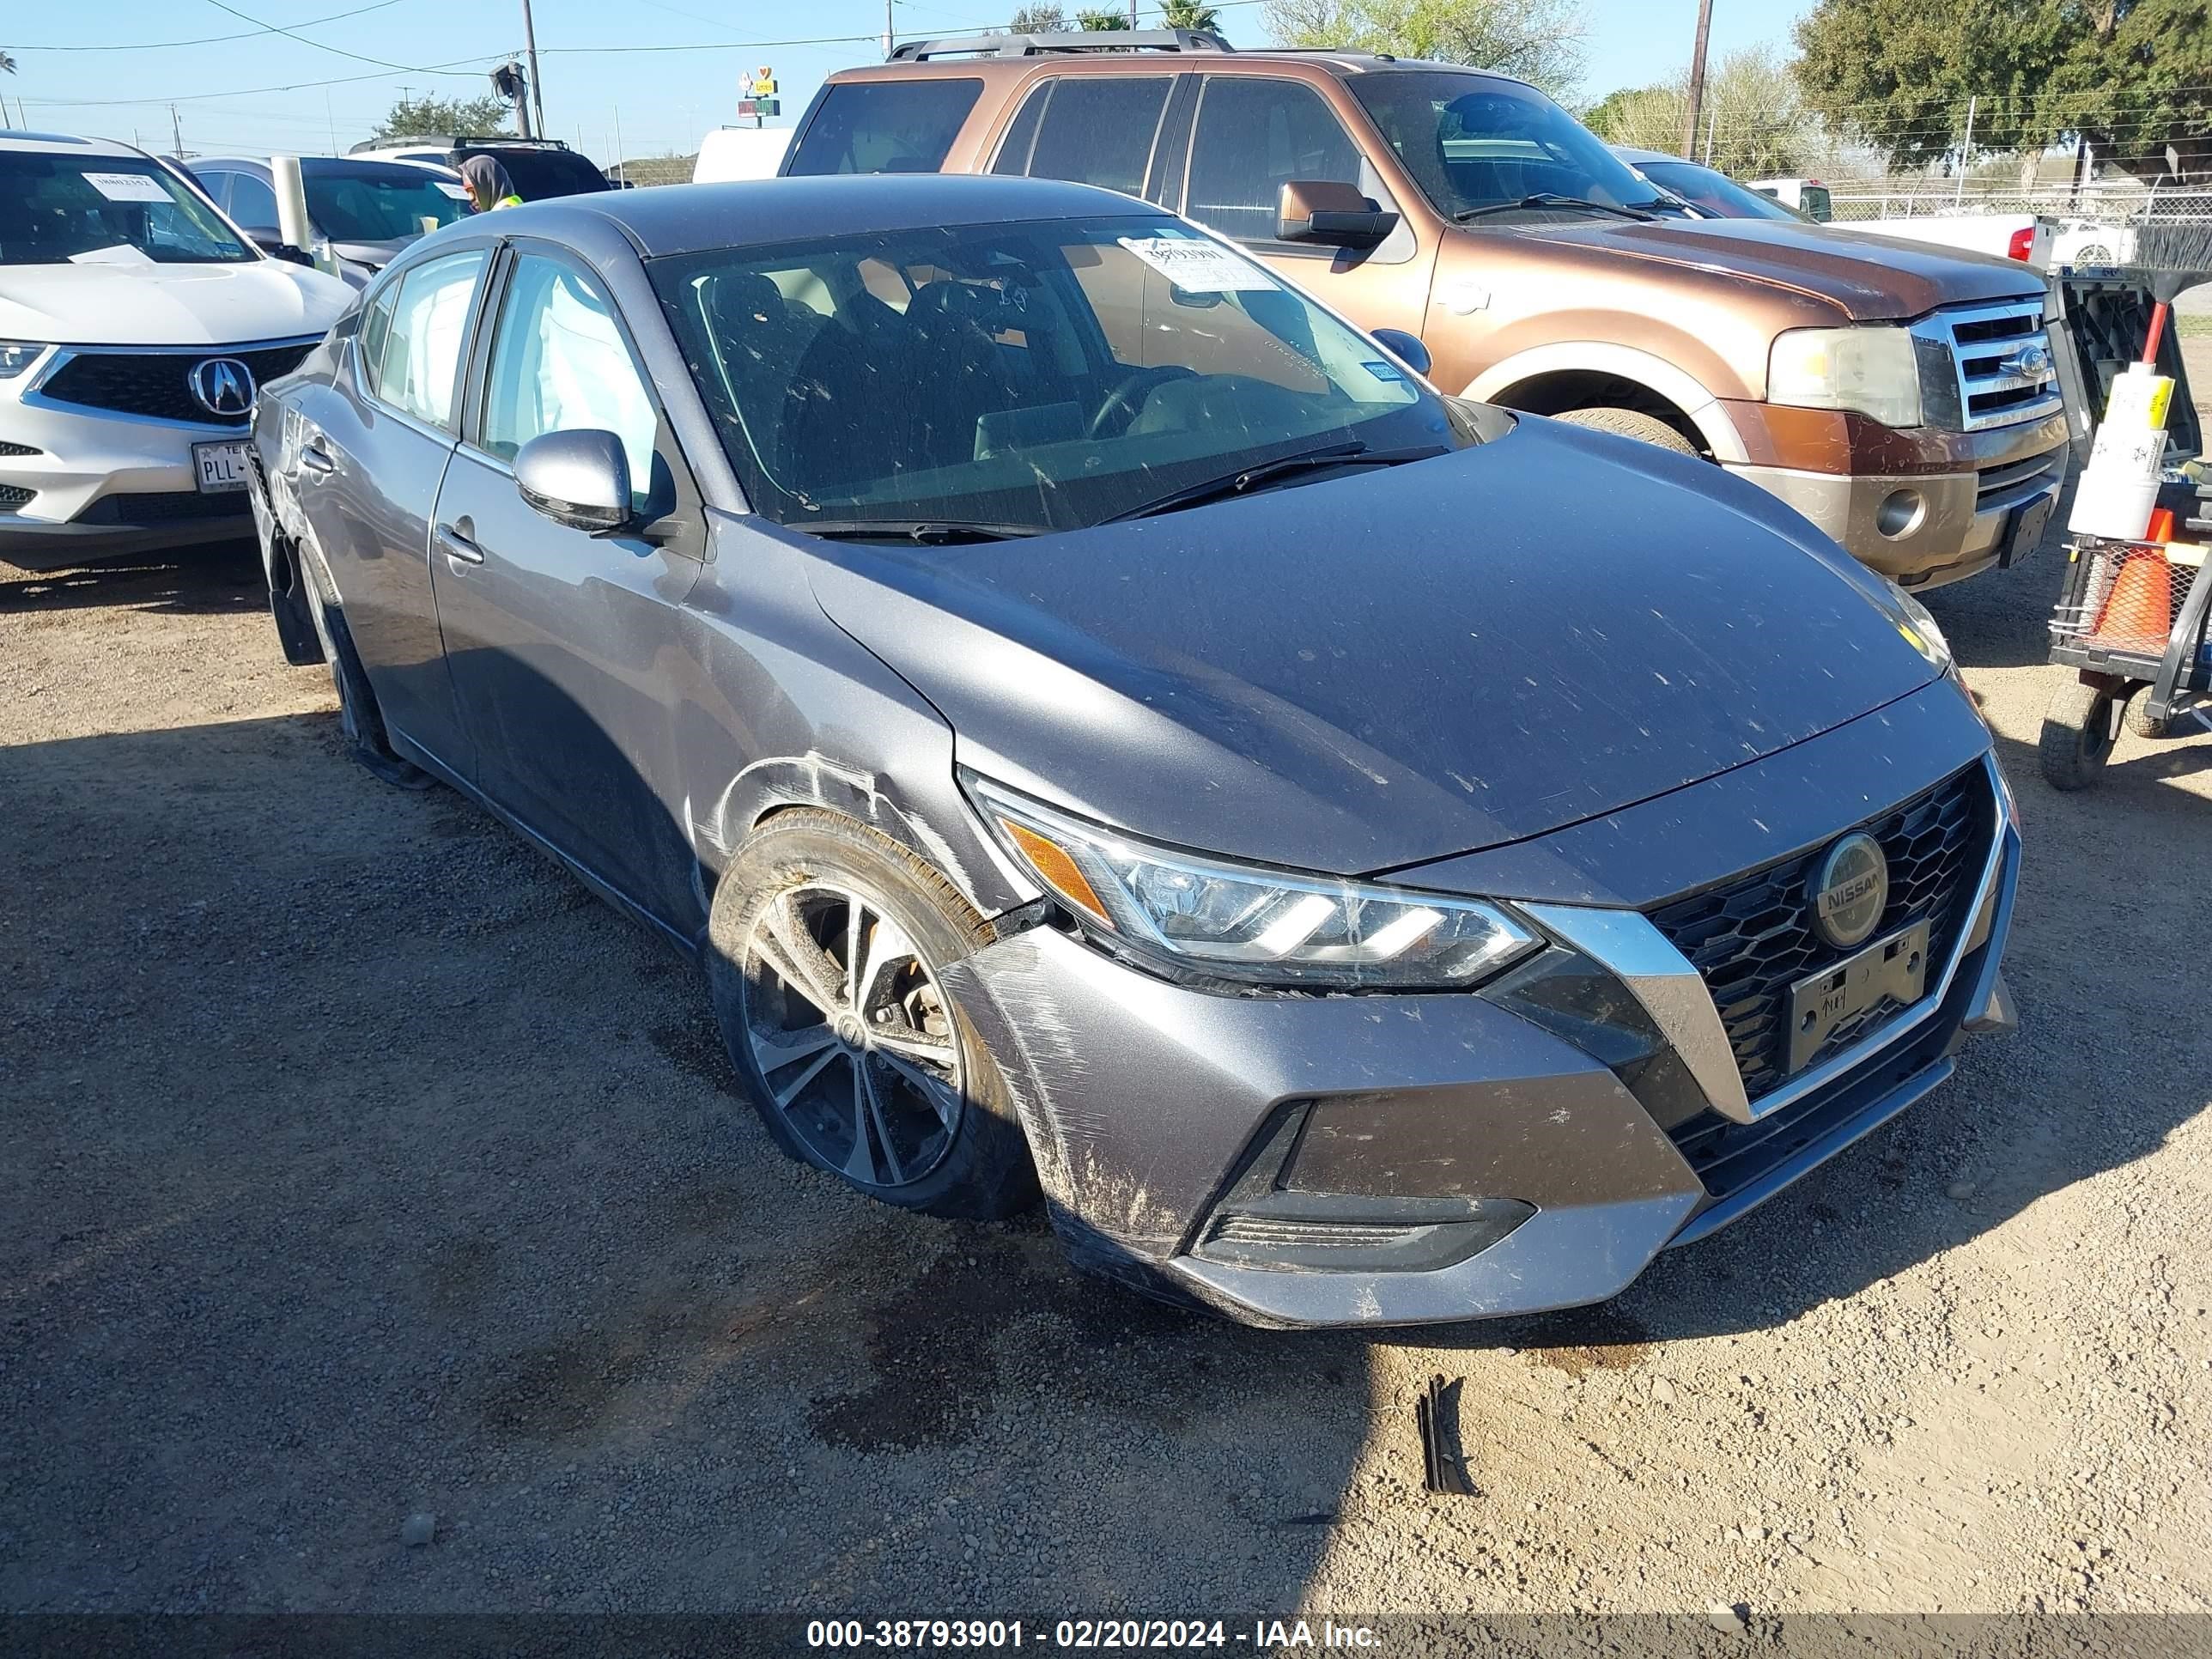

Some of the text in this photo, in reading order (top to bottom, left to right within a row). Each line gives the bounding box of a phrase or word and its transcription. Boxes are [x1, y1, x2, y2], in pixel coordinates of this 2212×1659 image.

[1145, 249, 1224, 259] 38793901
[204, 459, 236, 481] PLL
[1827, 872, 1883, 910] NISSAN
